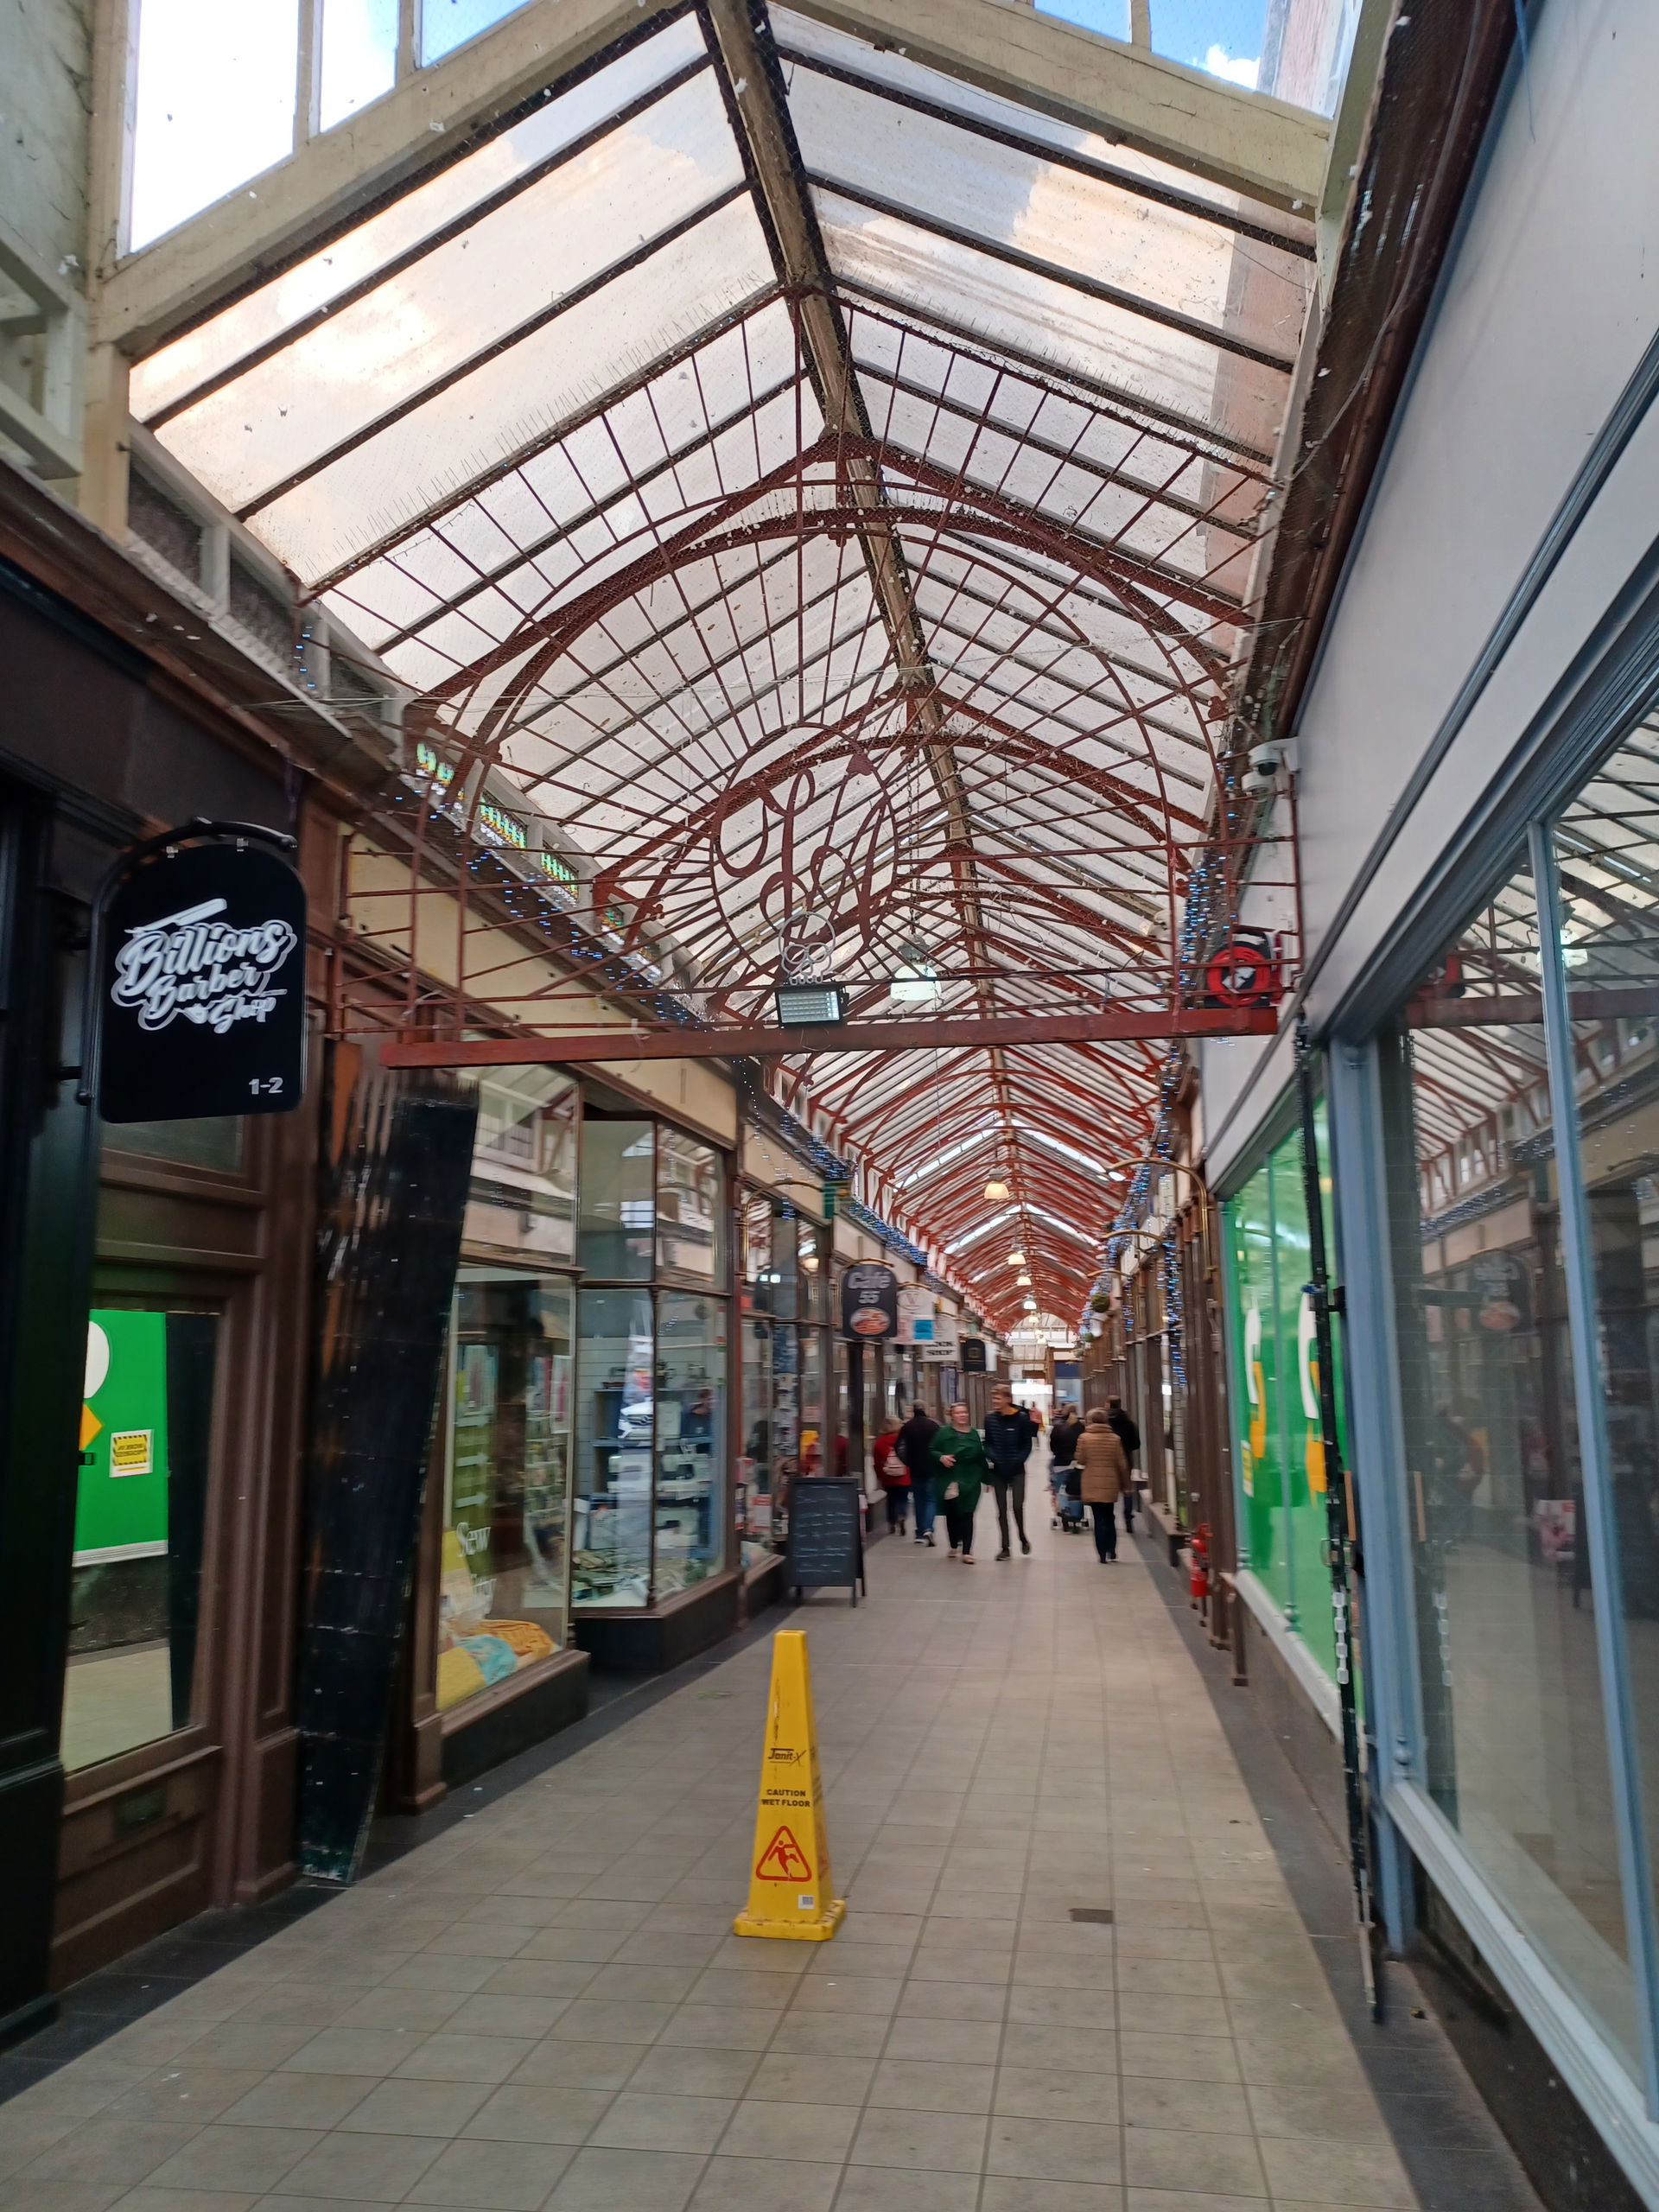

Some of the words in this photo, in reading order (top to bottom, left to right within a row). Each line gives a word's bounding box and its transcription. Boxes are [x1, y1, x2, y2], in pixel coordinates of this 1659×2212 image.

[118, 922, 291, 997] Billions
[143, 961, 259, 1020] Barber
[207, 995, 277, 1034] Shop
[248, 1077, 283, 1095] 1-2
[766, 1789, 806, 1797] CAUTION
[781, 1799, 810, 1808] FLOOR
